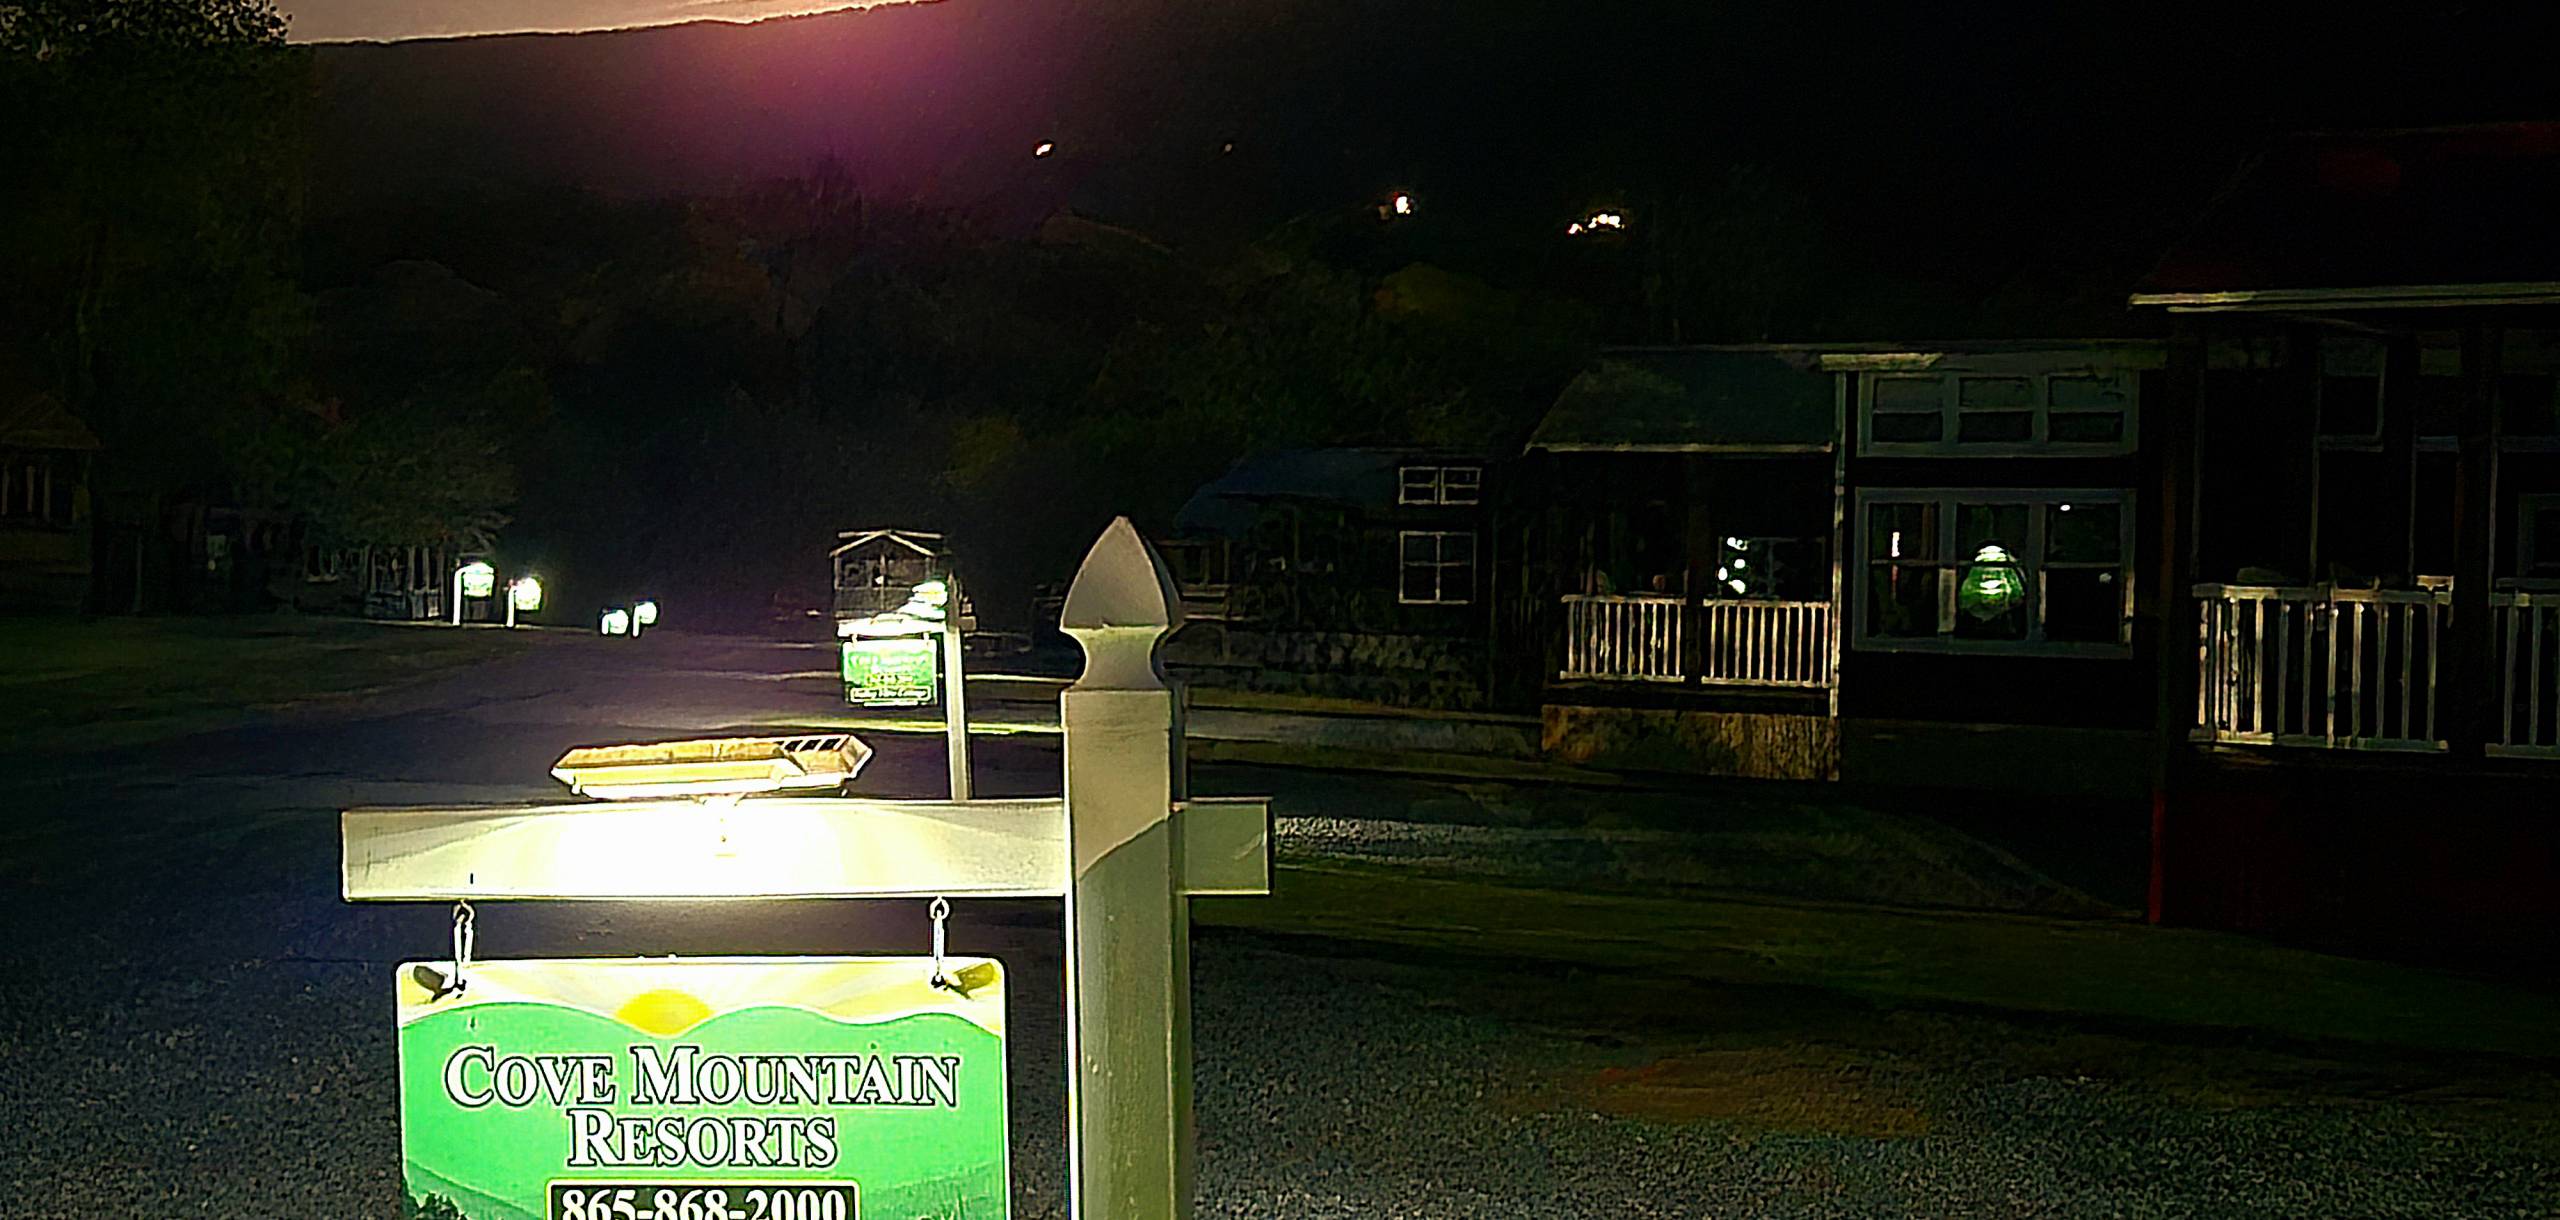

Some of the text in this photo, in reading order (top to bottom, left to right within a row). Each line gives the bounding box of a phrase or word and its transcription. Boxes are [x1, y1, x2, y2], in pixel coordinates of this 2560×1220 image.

[445, 1045, 960, 1107] COVE MOUNTAIN
[566, 1108, 838, 1168] RESORTS
[561, 1189, 847, 1220] 865-868-2000
